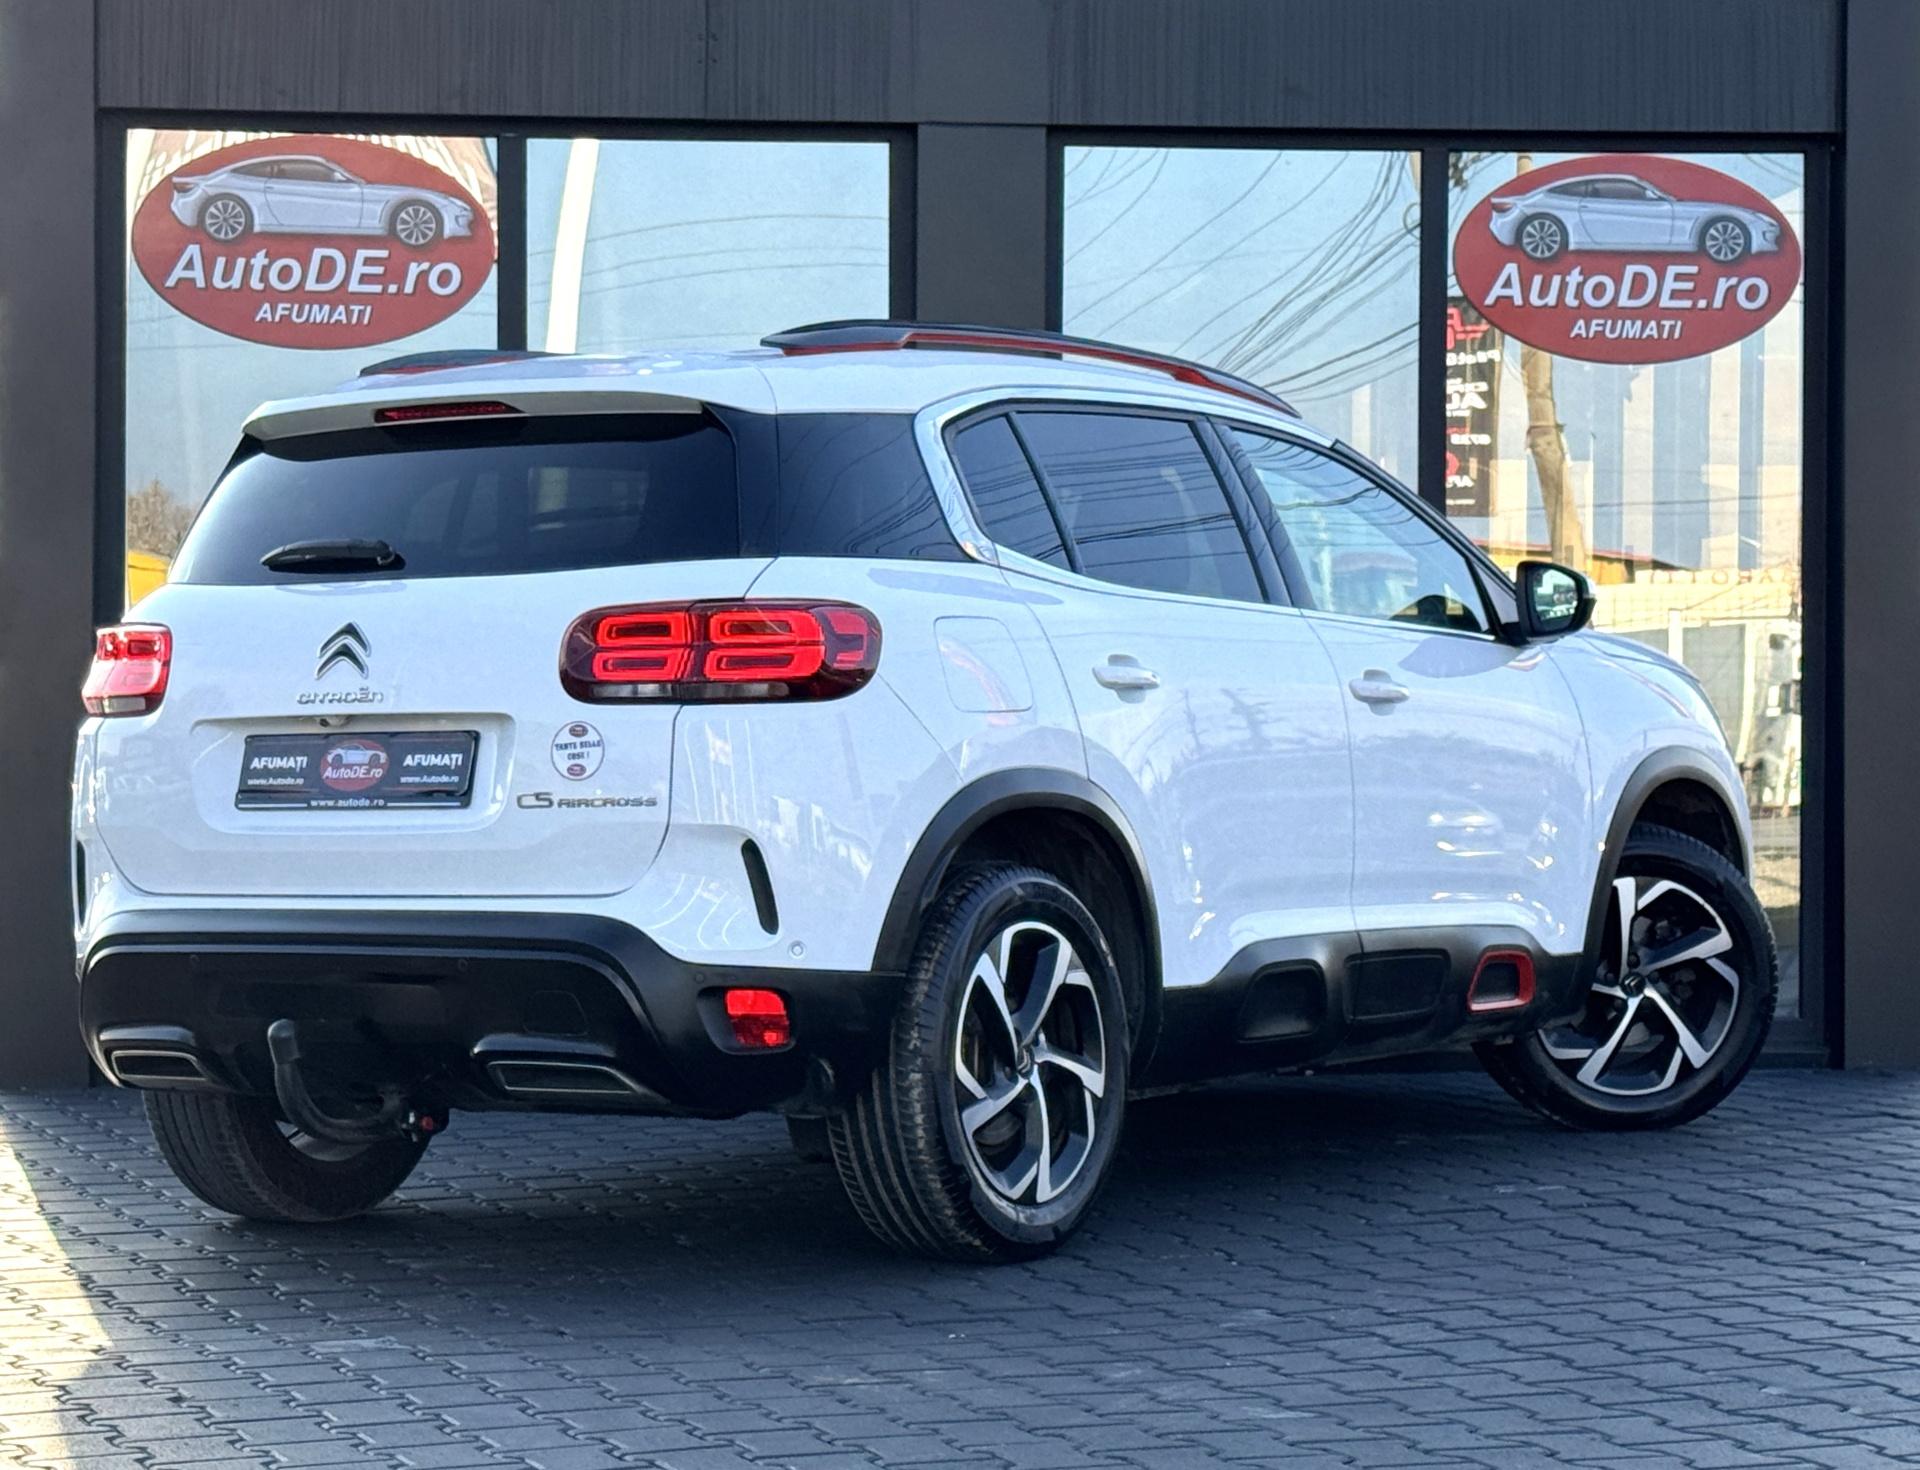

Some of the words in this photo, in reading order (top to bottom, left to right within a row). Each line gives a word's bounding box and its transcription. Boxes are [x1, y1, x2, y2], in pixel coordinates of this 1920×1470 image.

[164, 243, 463, 295] AutoDE.ro
[1483, 262, 1771, 311] AutoDE.ro
[255, 302, 373, 326] AFUMATI
[1569, 318, 1683, 340] AFUMATI
[322, 765, 384, 780] AutoDE.ro
[310, 798, 385, 808] www.autode.ro
[516, 792, 554, 809] C5
[557, 796, 658, 809] AIRCROSS
